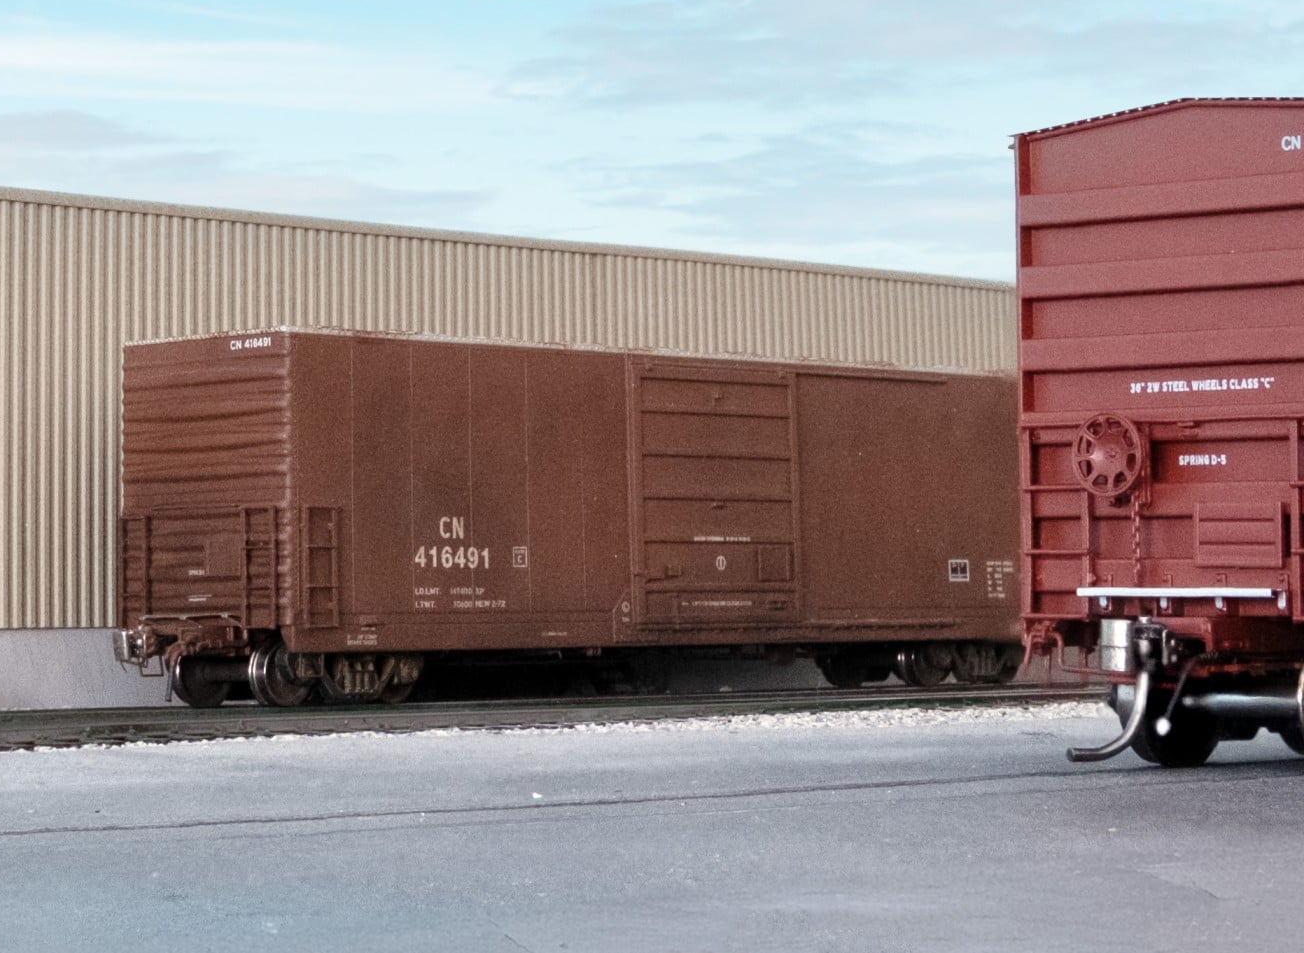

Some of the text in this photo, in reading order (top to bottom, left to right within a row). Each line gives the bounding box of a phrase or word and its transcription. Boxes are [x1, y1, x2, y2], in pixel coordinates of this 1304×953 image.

[1281, 136, 1301, 151] CN
[230, 337, 272, 350] CN 416491
[1147, 382, 1160, 393] 2W
[1162, 381, 1189, 392] STEEL
[1191, 379, 1227, 391] WHEELS
[1229, 378, 1258, 390] CLASS
[1178, 455, 1209, 465] SPRING
[439, 516, 464, 539] CN
[414, 546, 489, 569] 416491
[517, 555, 523, 564] C
